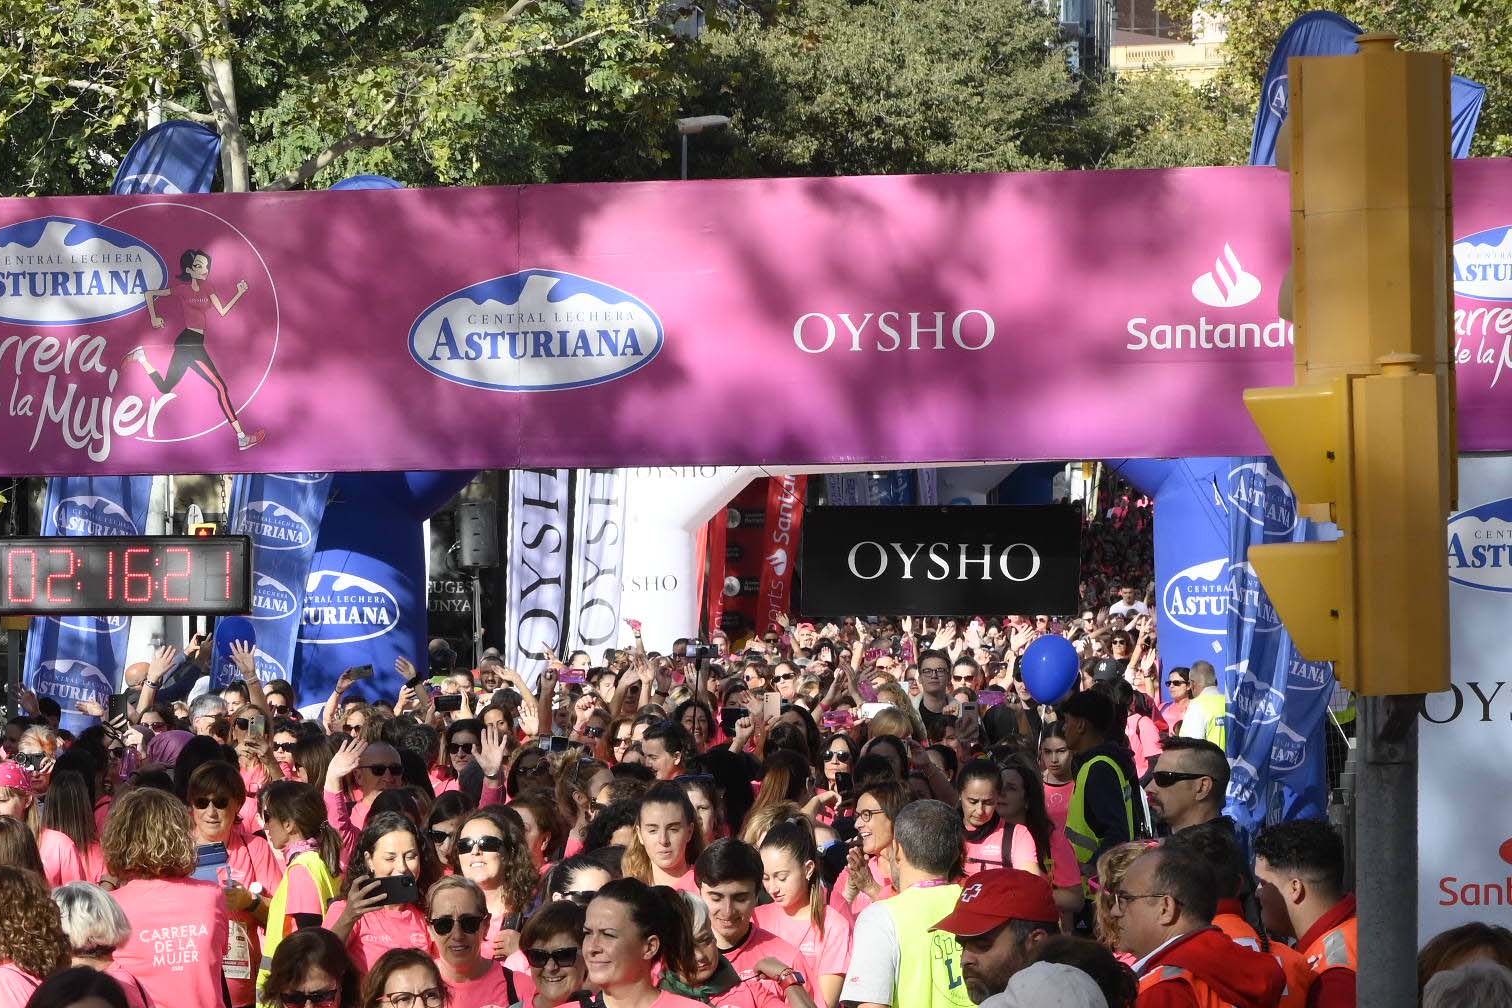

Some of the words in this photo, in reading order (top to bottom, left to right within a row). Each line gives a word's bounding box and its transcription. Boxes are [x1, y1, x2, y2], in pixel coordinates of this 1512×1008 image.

[70, 252, 143, 264] LECHERA
[467, 311, 546, 325] CENTRAL
[554, 309, 635, 323] LECHERA
[793, 309, 995, 354] OYSHO
[428, 316, 643, 361] ASTURIANA
[1126, 317, 1294, 351] Santand
[1477, 336, 1495, 364] la
[10, 377, 33, 416] la
[29, 369, 177, 463] Mujer
[7, 548, 232, 603] 02:16:21
[848, 541, 1041, 581] OYSHO
[337, 595, 386, 604] LECHERA
[1170, 586, 1229, 616] ASTU
[140, 923, 209, 943] CARRERA
[154, 940, 174, 954] DE
[179, 938, 196, 951] LA
[153, 950, 199, 967] MUJER
